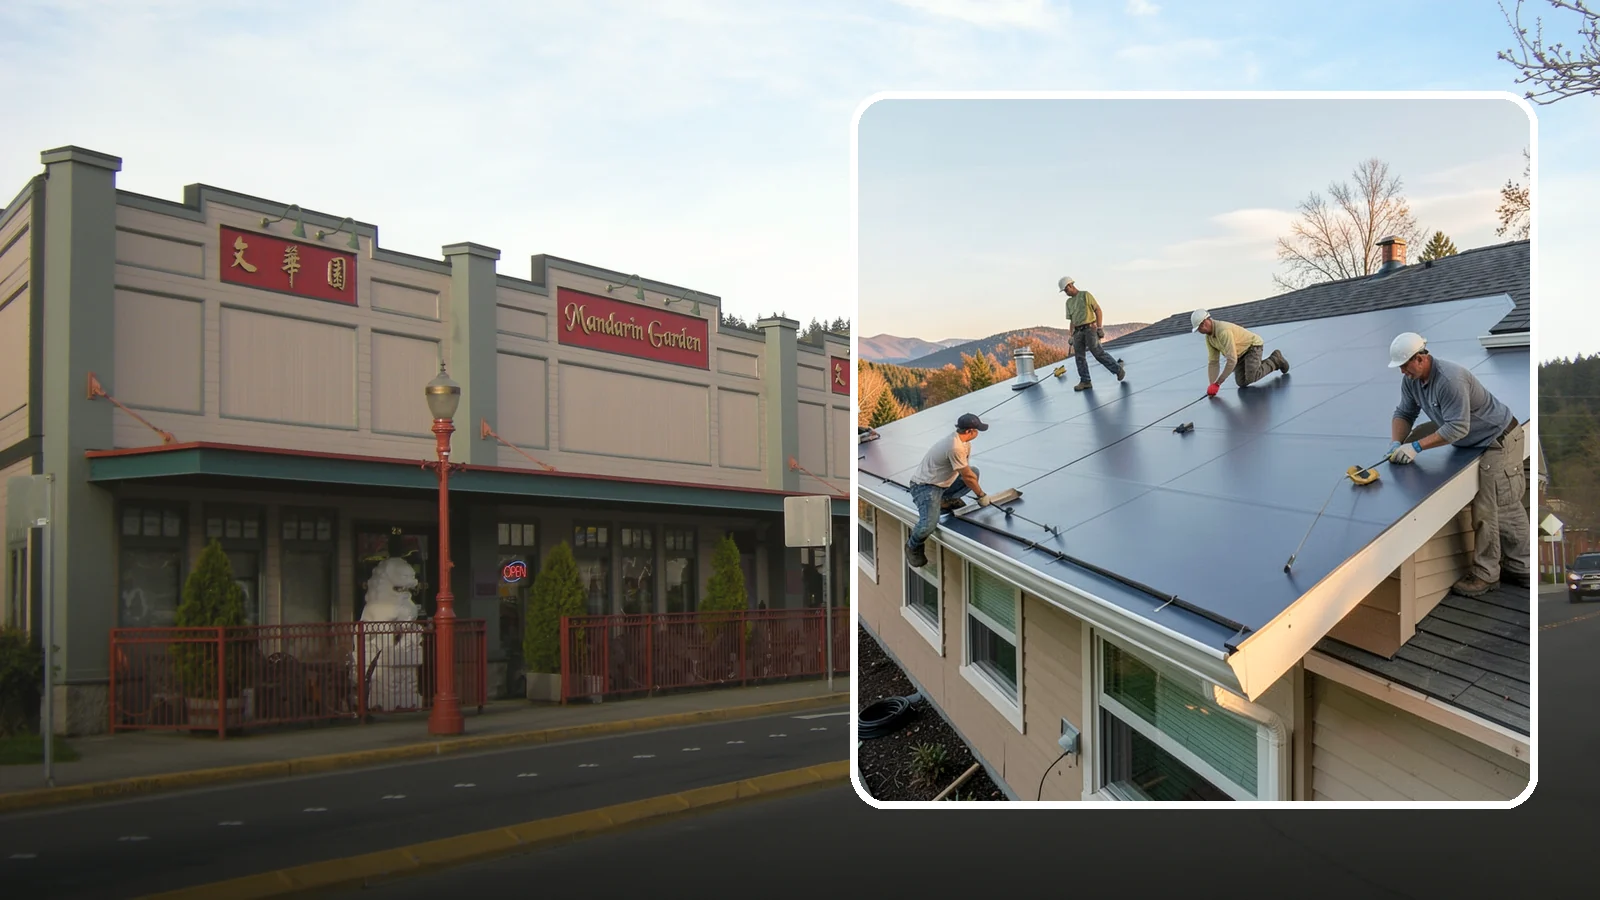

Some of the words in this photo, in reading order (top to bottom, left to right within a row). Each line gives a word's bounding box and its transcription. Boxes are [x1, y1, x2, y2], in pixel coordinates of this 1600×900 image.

[230, 235, 346, 291] 文華園
[564, 302, 644, 340] Mandarin
[648, 320, 702, 352] Garden
[503, 565, 527, 579] OPEN
